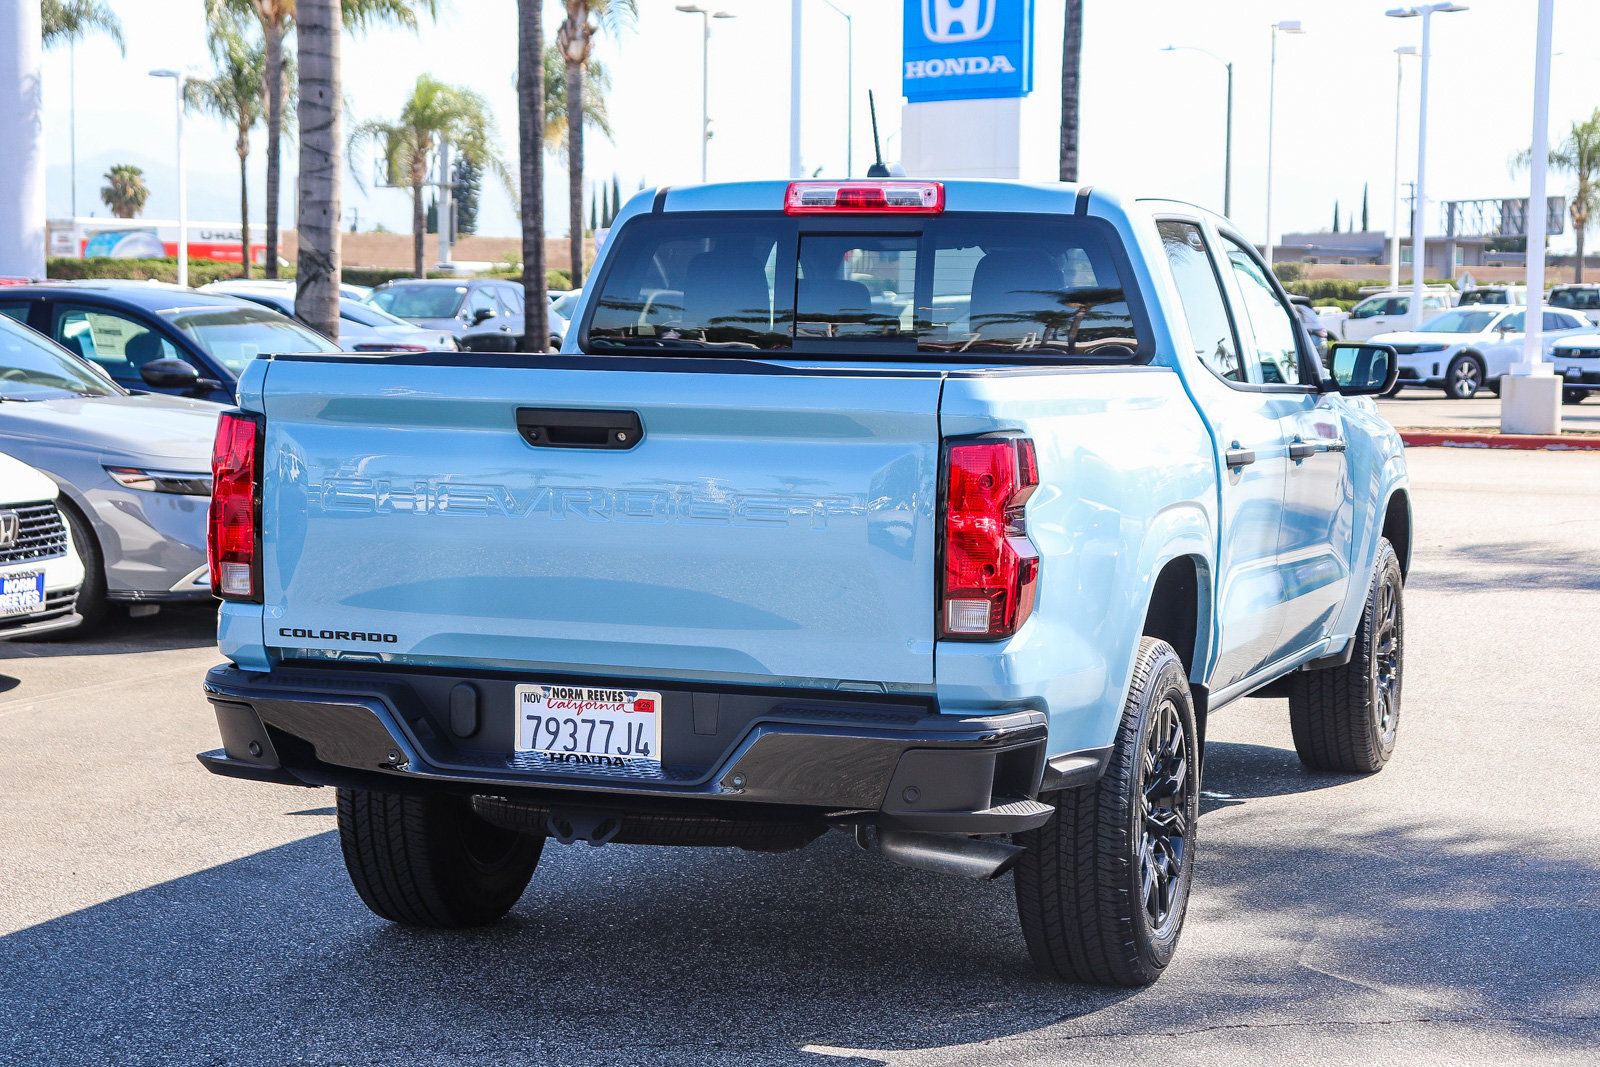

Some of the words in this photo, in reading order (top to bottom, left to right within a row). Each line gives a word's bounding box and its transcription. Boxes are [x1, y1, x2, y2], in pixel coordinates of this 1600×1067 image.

[904, 55, 1016, 80] HONDA
[321, 478, 852, 531] CHEVROLET
[279, 627, 398, 644] COLORADO
[523, 693, 541, 703] NOV
[552, 687, 583, 700] NORM
[587, 689, 624, 703] REEVES
[546, 697, 636, 716] California
[526, 714, 651, 757] 79377J4
[549, 752, 626, 767] HONDA
